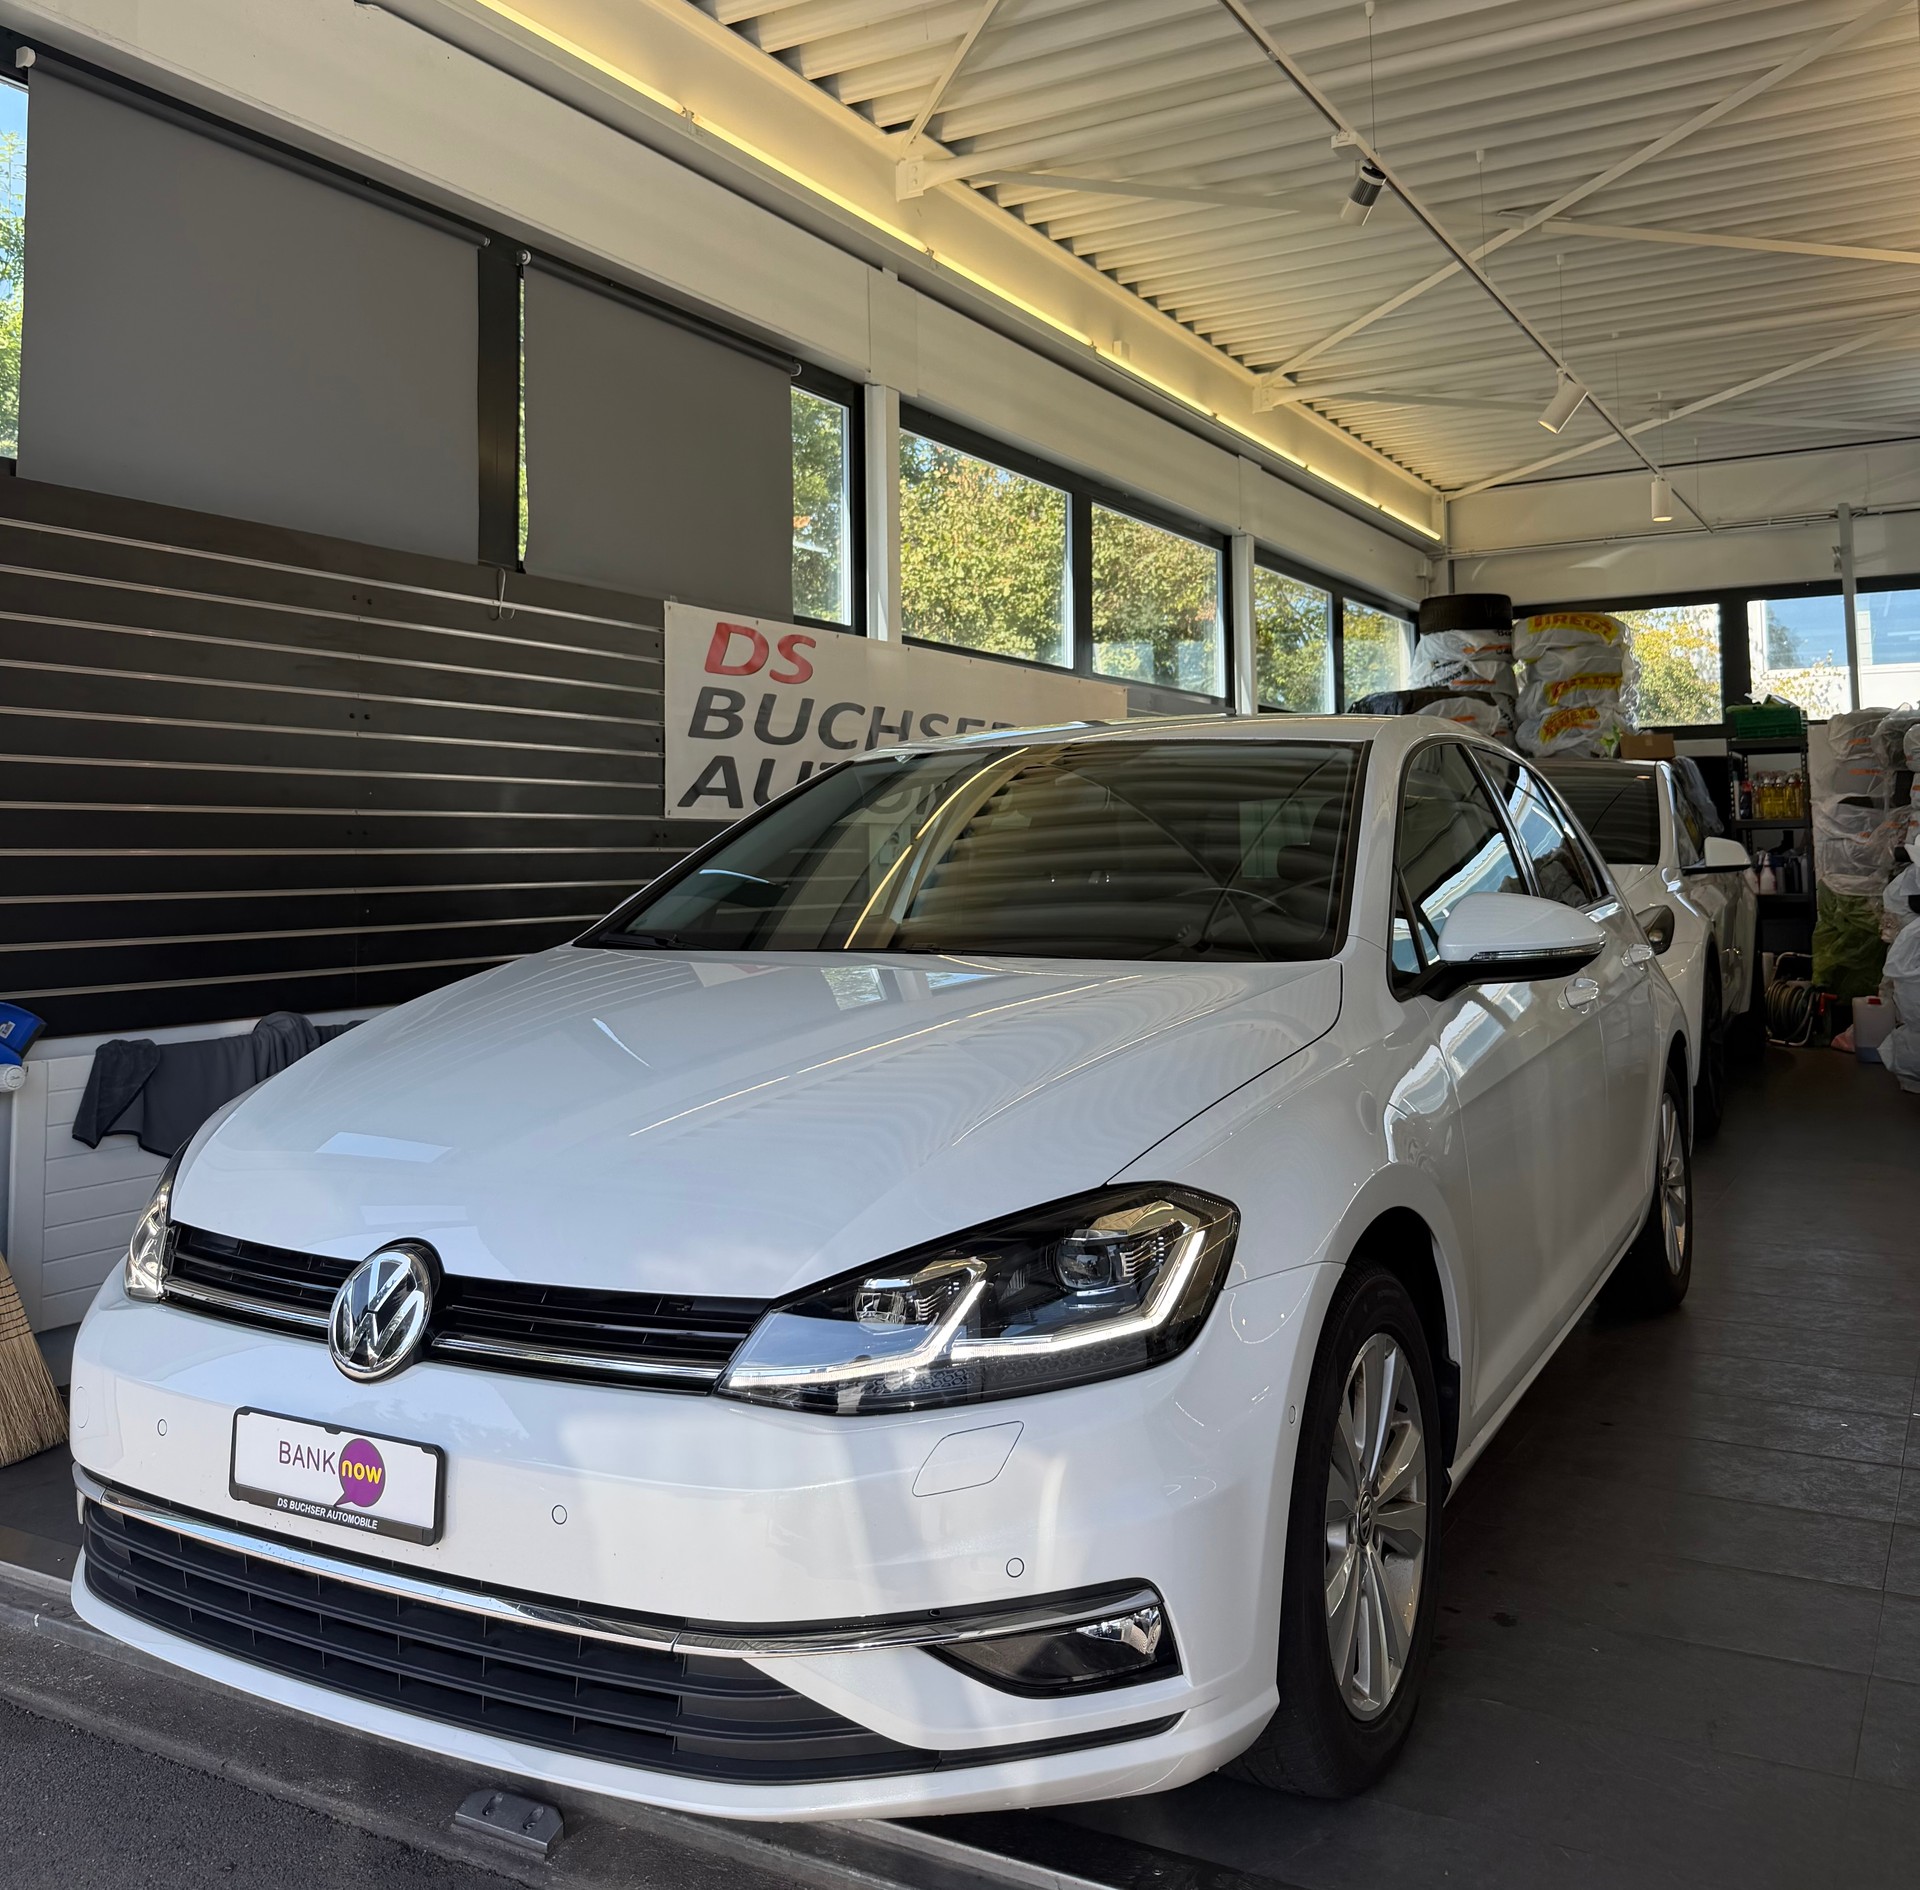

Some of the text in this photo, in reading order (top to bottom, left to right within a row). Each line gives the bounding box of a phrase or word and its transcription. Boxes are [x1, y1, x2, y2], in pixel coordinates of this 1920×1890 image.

[705, 622, 816, 684] DS
[688, 686, 1016, 751] BUCHS
[279, 1440, 382, 1484] BANK now
[277, 1497, 378, 1530] DS BUCHSER AUTOMOBILE
